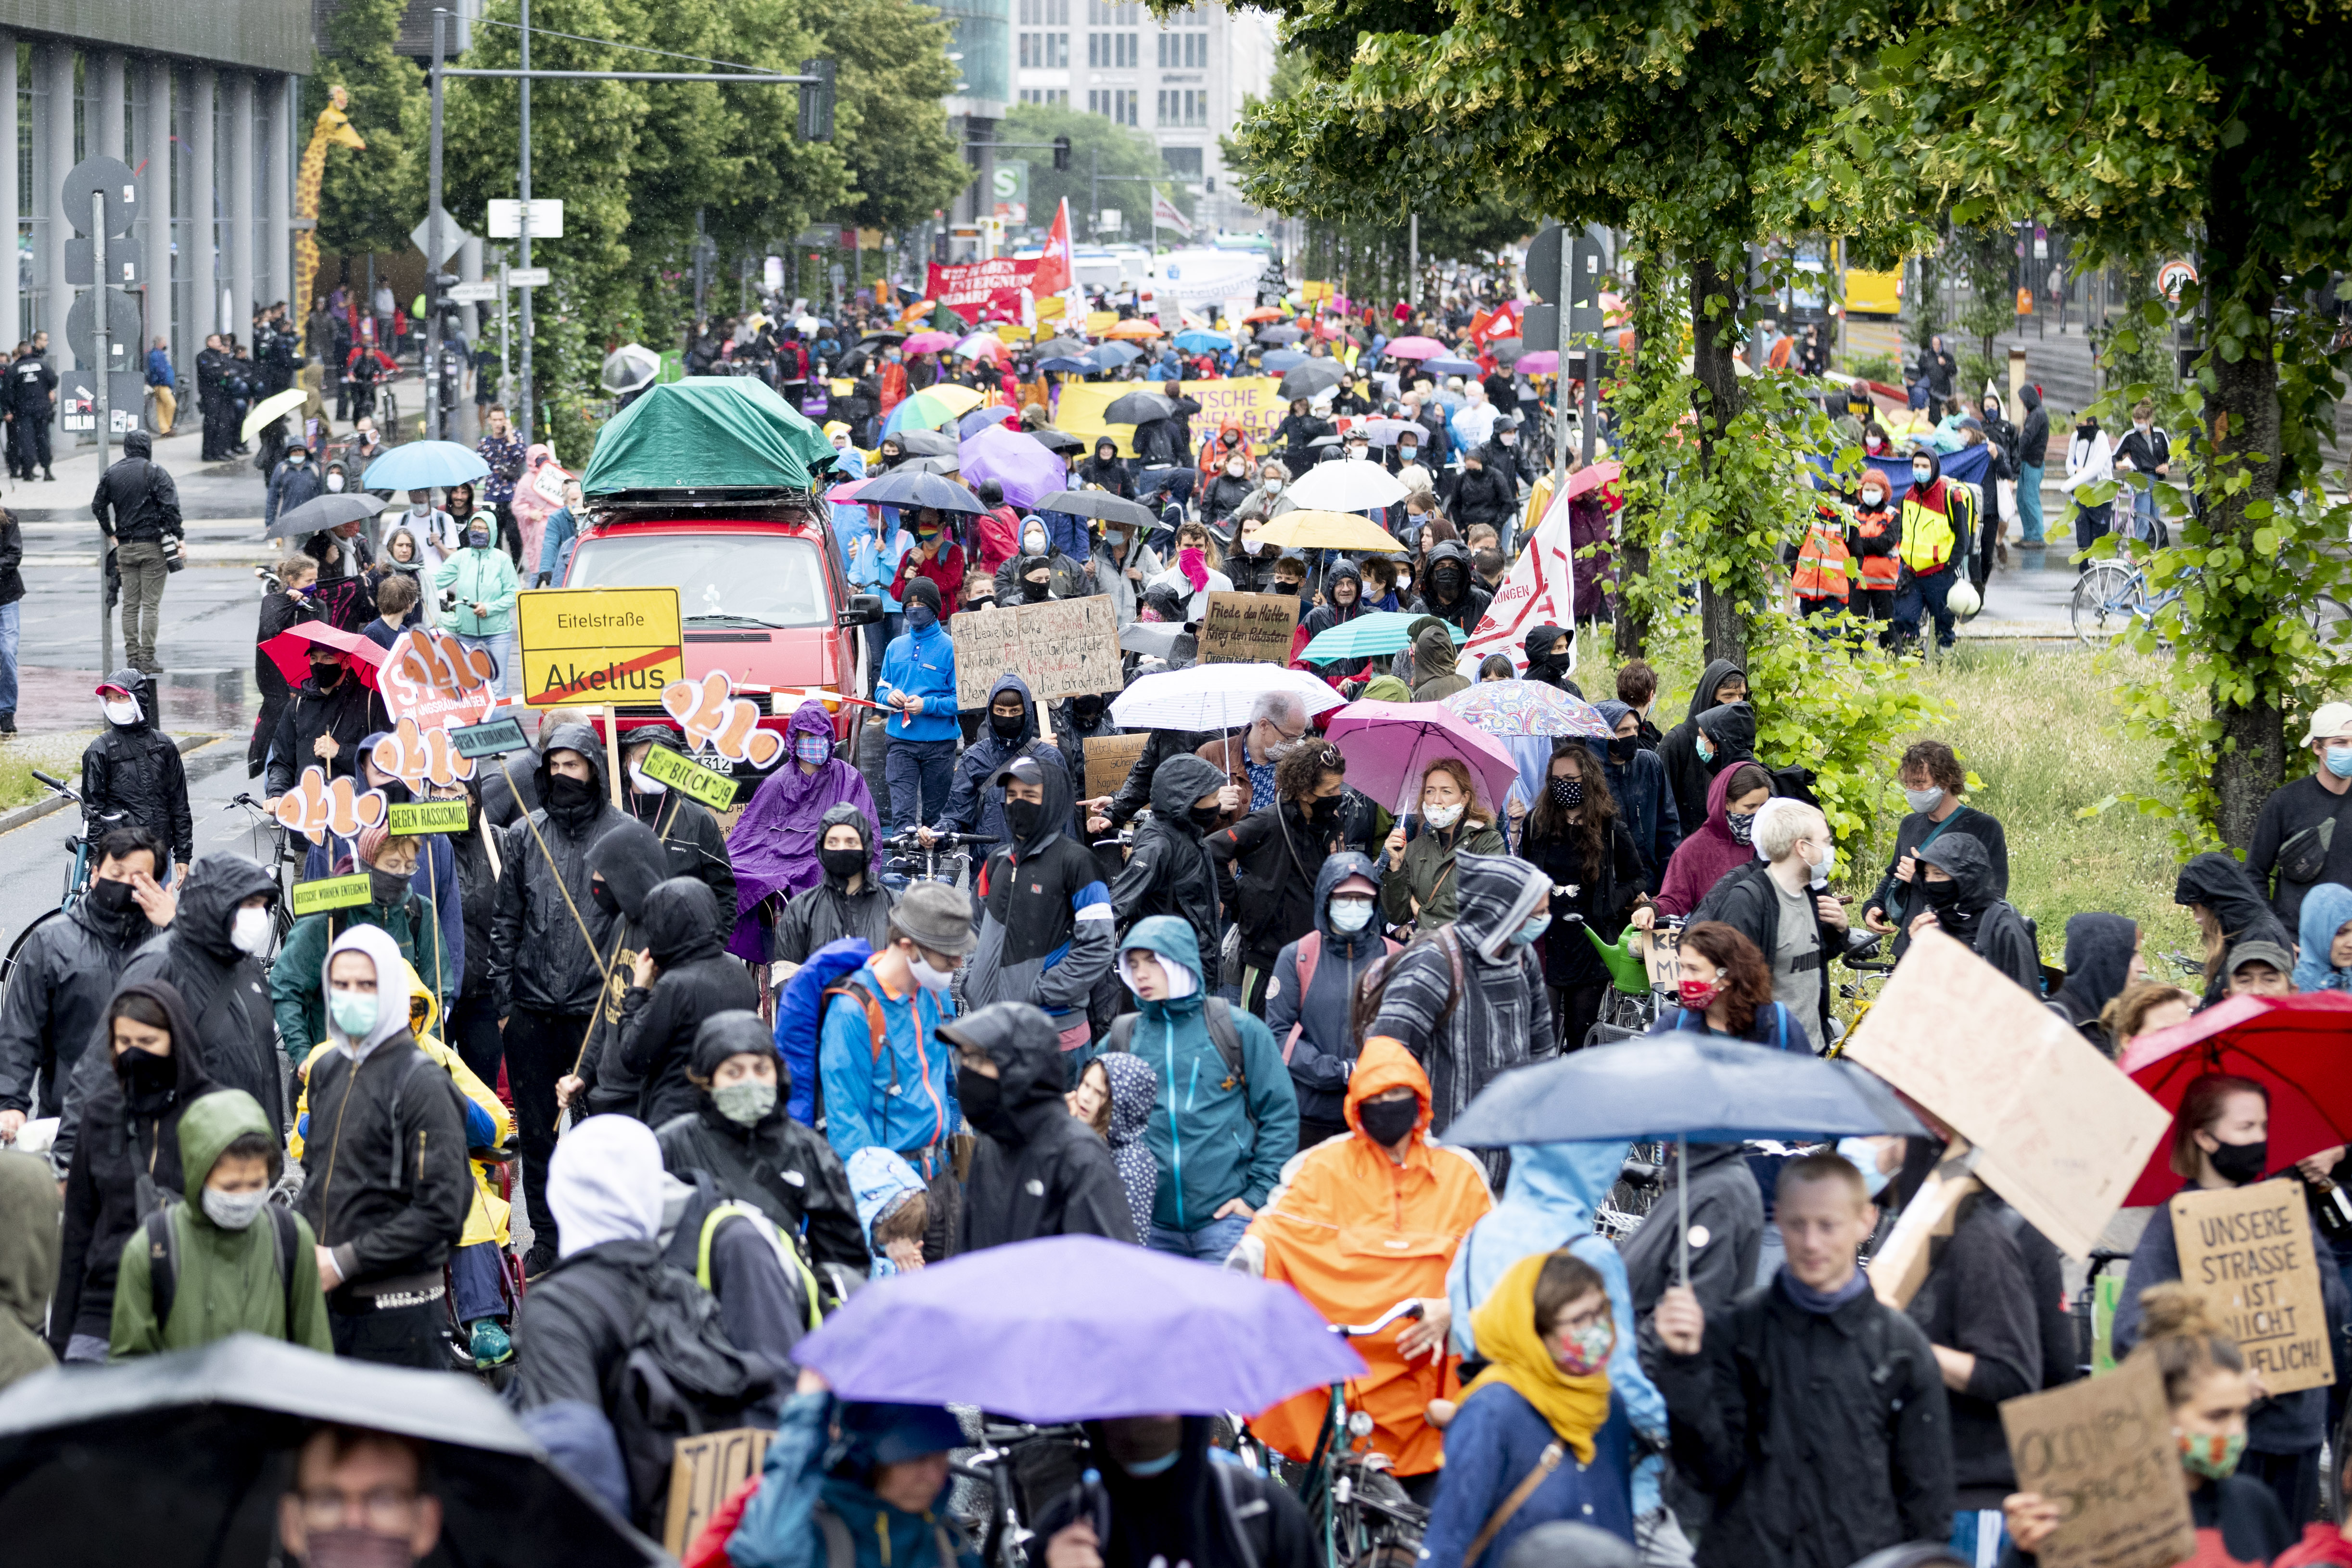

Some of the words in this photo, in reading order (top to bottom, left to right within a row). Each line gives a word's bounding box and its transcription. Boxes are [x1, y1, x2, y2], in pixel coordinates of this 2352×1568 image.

[993, 169, 1017, 198] S
[64, 415, 95, 430] MLM
[558, 612, 645, 628] Eitelstraße
[1210, 601, 1241, 618] Friede
[1244, 605, 1258, 619] den
[1258, 604, 1290, 622] Hütten
[1206, 623, 1227, 647] Krieg
[1231, 626, 1246, 640] den
[961, 653, 975, 669] Wir
[979, 648, 1002, 668] haben
[1029, 646, 1043, 658] für
[1047, 632, 1102, 656] Geflüchtete
[544, 662, 665, 692] Akelius
[1003, 663, 1021, 675] und
[961, 680, 988, 702] Dem
[1038, 674, 1055, 694] die
[1088, 739, 1113, 754] Arbeit
[1097, 774, 1120, 792] Kapital
[392, 809, 418, 829] GEGEN
[421, 806, 466, 826] RASSISMUS
[295, 889, 317, 905] DEUTSCHE
[319, 886, 340, 902] WOHNEN
[341, 882, 369, 898] ENTEIGNEN
[2199, 1205, 2293, 1248] UNSERE
[2201, 1240, 2299, 1285] STRASSE
[2242, 1279, 2277, 1309] IST
